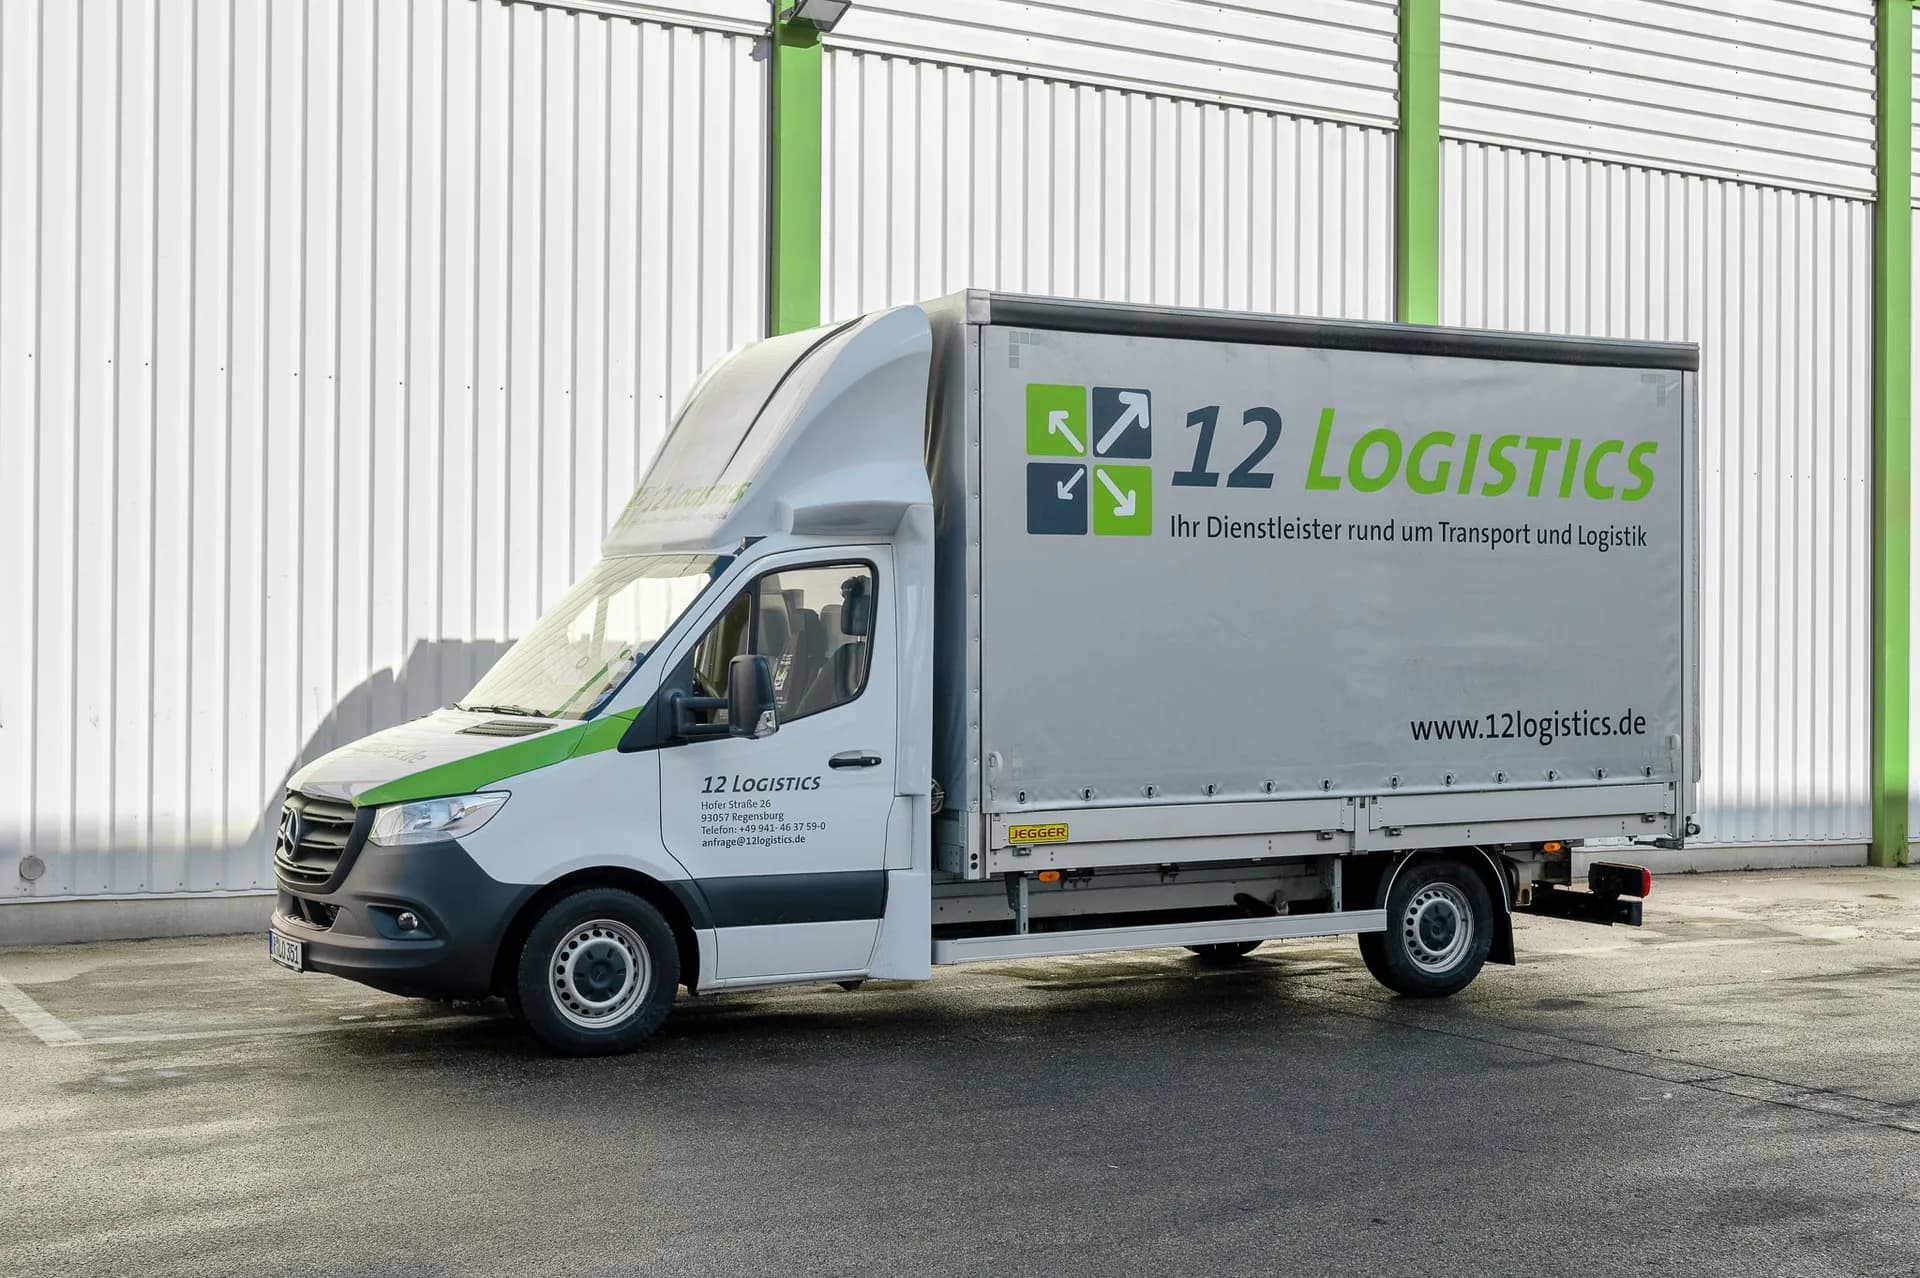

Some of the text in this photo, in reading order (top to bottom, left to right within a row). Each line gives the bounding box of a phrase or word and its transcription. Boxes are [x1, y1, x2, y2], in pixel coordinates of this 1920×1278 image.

[1171, 405, 1659, 502] 12 LOGISTICS
[1171, 513, 1647, 553] Ihr Dienstleister rund um Transport und Logistik
[1410, 707, 1646, 746] www.12logistics.de
[701, 774, 821, 794] 12 LOGISTICS
[701, 799, 772, 810] Hofer Straße 26
[701, 811, 785, 824] 93057 Regensburg
[701, 825, 738, 835] Telefon:
[739, 824, 757, 833] +49
[793, 822, 805, 832] 37
[806, 821, 826, 831] 59-0
[1011, 827, 1065, 839] JEGGER
[702, 834, 806, 849] anfrage@12logistics.de
[286, 937, 299, 953] 351
